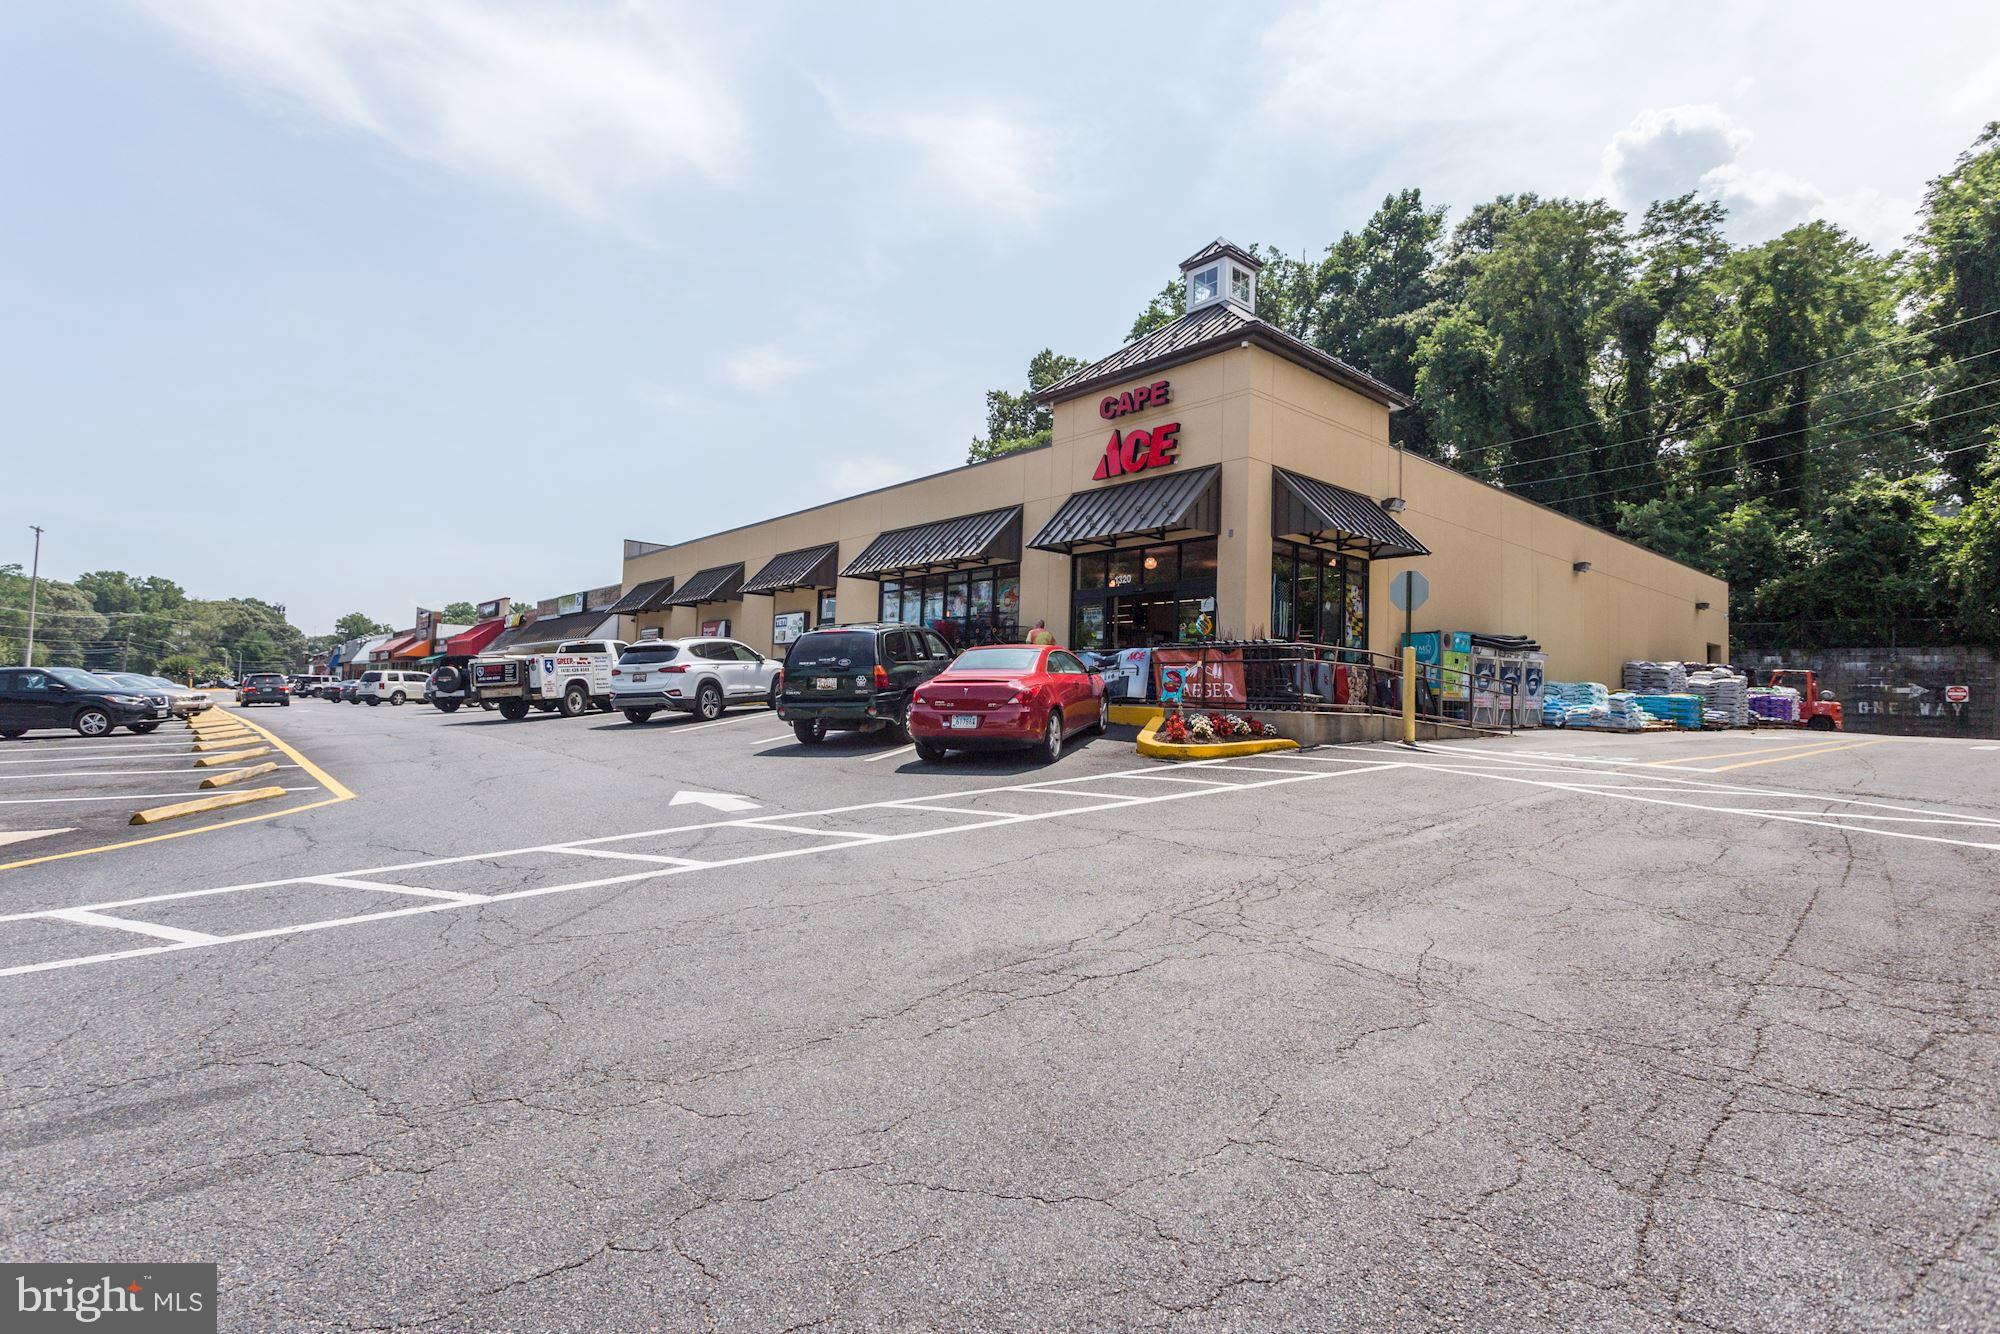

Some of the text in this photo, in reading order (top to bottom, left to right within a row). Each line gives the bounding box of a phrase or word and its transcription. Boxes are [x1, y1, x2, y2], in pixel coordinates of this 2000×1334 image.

[1100, 381, 1169, 420] CAPE
[1092, 422, 1180, 480] ACE
[1115, 574, 1132, 584] 1320
[1127, 651, 1146, 660] ACE
[1183, 682, 1234, 698] AEGER
[1920, 703, 1962, 716] WAY
